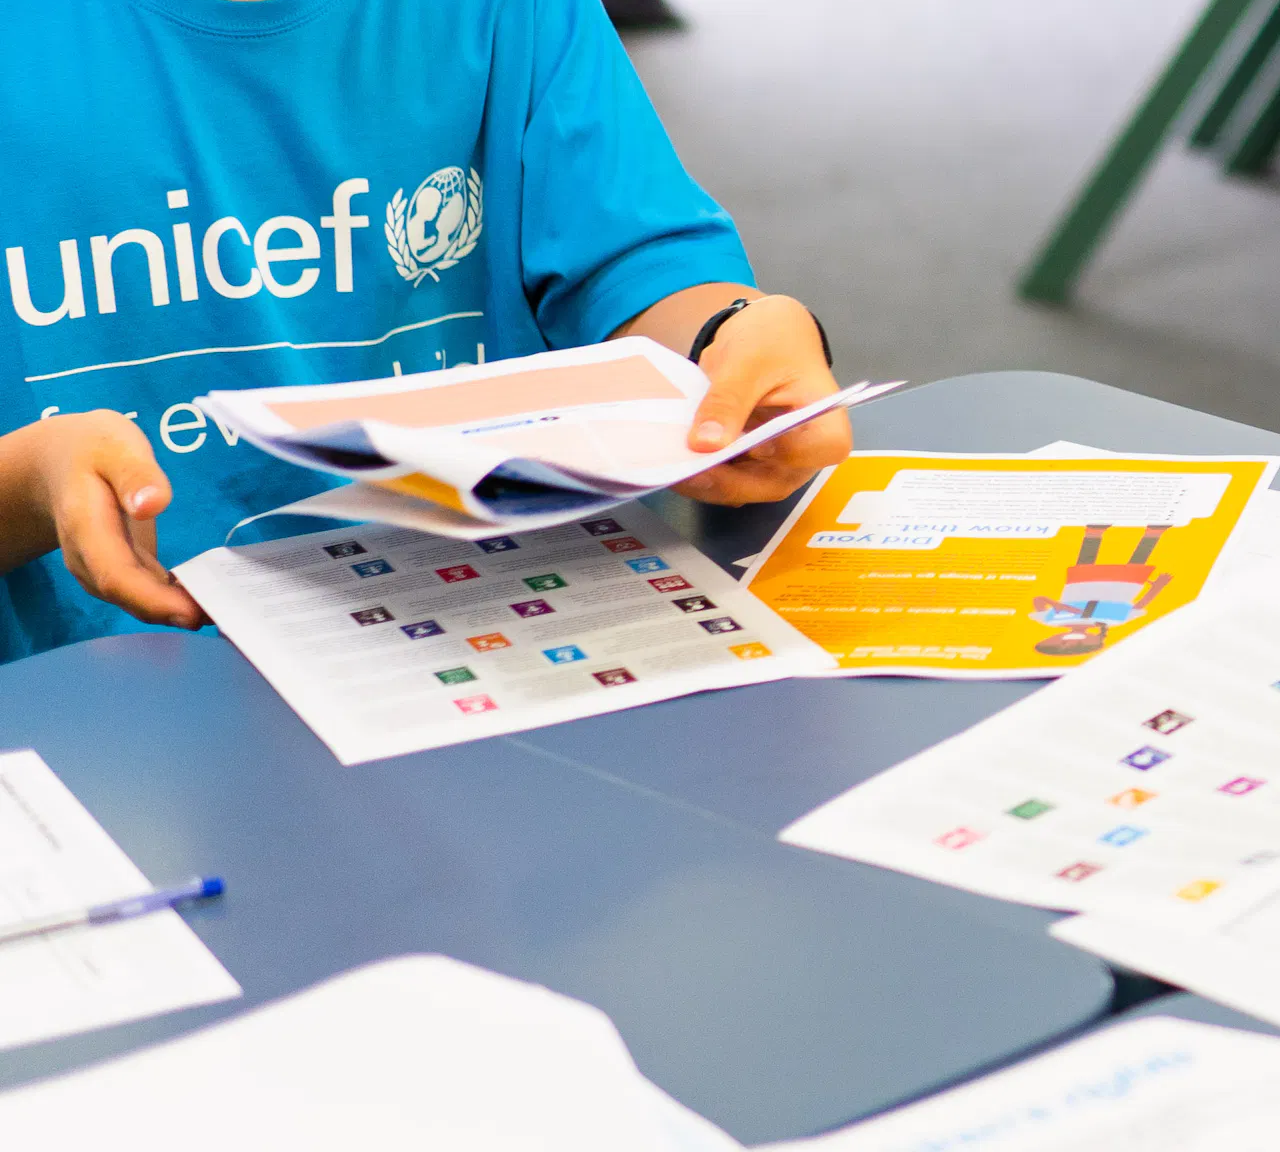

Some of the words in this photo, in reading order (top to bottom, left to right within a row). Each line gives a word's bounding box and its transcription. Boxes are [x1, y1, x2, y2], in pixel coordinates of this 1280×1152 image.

[6, 177, 370, 327] unicef
[968, 525, 1050, 535] know
[817, 533, 875, 543] you
[882, 536, 933, 545] Did
